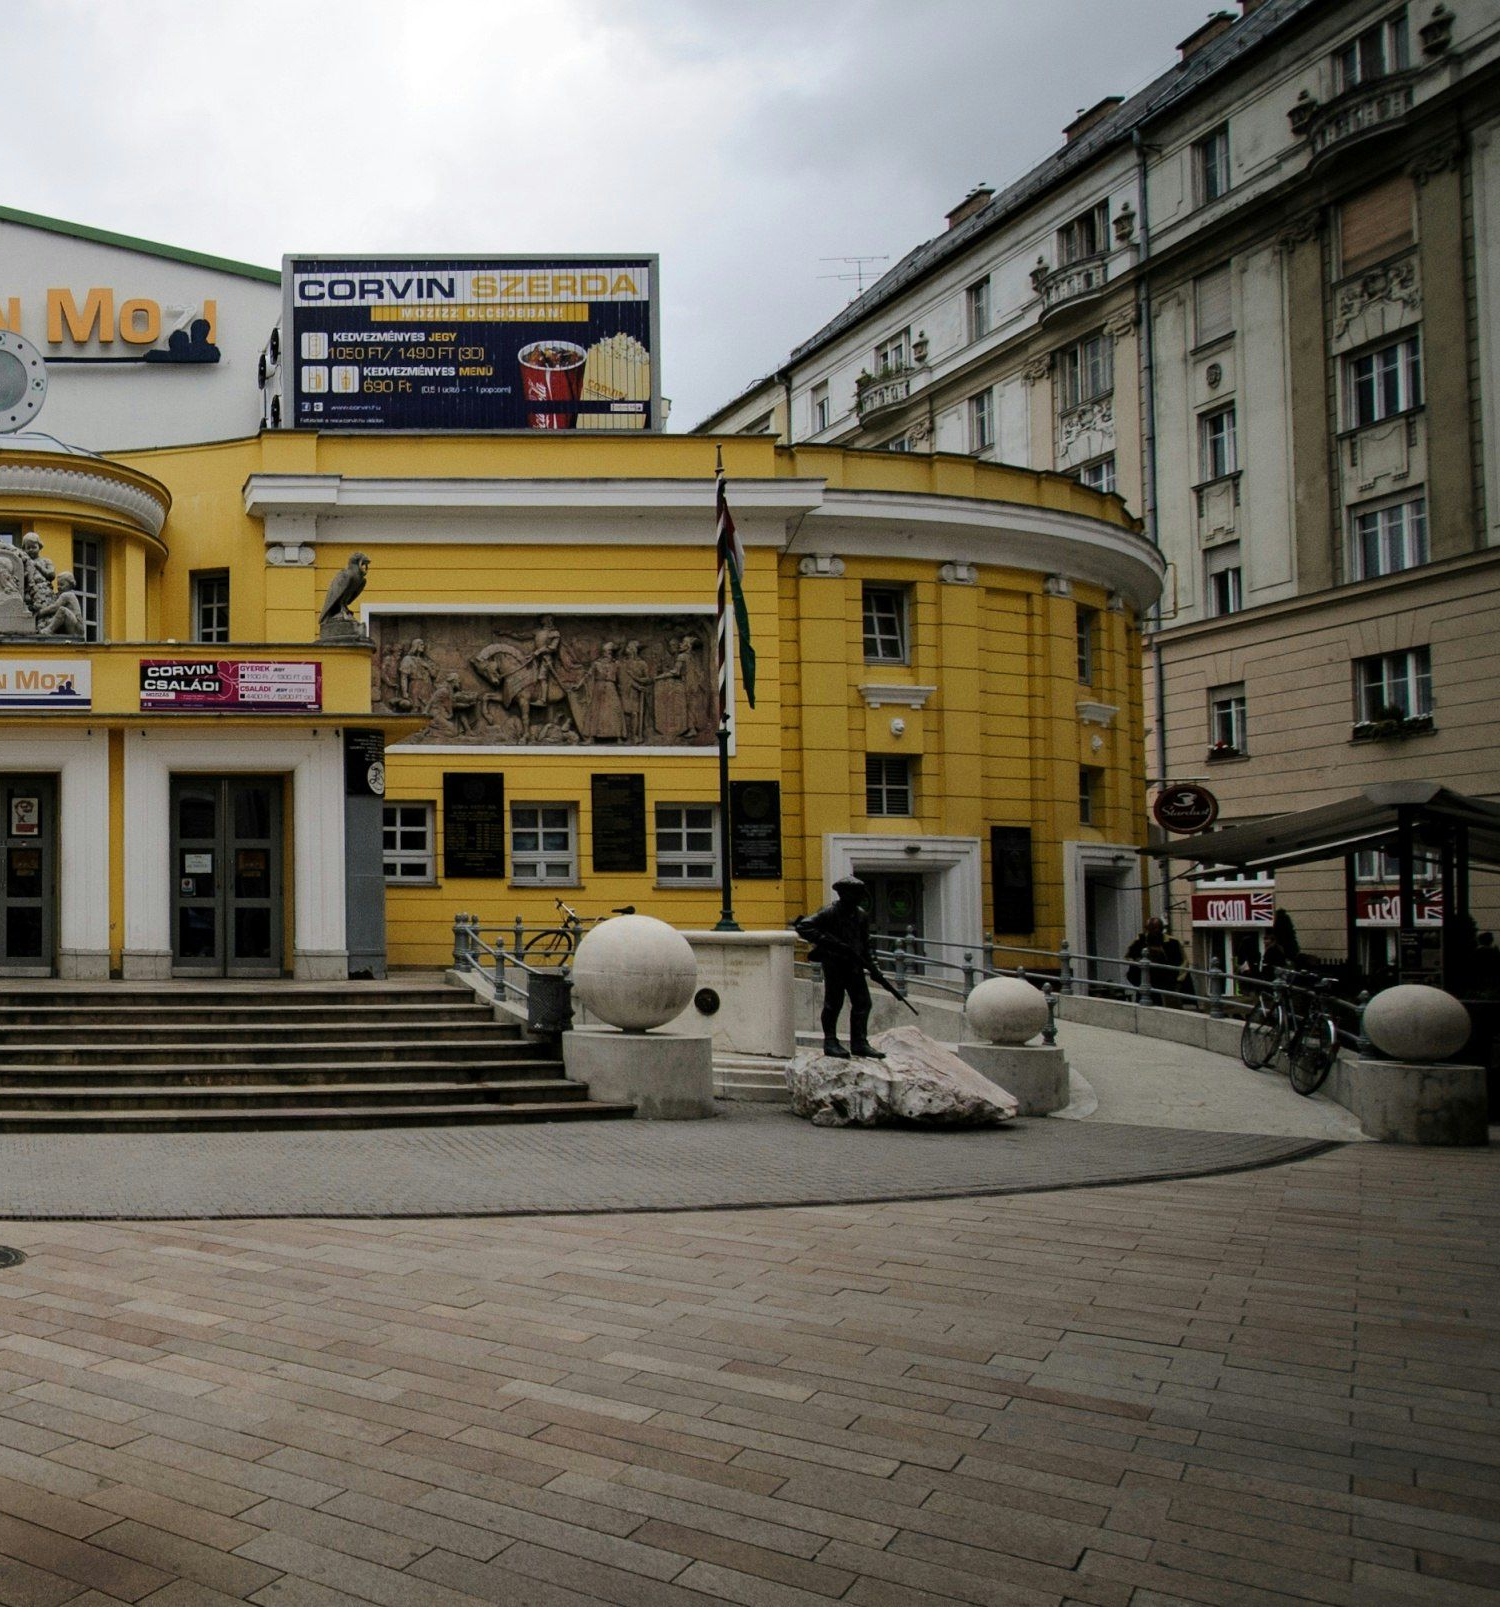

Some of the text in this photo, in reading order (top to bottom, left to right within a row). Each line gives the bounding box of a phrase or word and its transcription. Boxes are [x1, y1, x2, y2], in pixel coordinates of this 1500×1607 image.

[298, 274, 639, 301] CORVIN SZERDA
[401, 303, 564, 318] MOZIZZ OLCSÓBBAN!
[332, 331, 457, 342] KEDVEZMÉNYES JEGY
[328, 346, 365, 360] 1050
[398, 346, 435, 360] 1490
[363, 364, 493, 376] KEDVEZMÉNYES MENÜ
[363, 379, 393, 393] 690
[398, 379, 413, 393] Ft
[147, 664, 214, 677] CORVIN
[15, 670, 75, 690] MOZI
[144, 678, 220, 692] CSALÁDI
[1161, 804, 1210, 817] Stardust
[1206, 899, 1247, 921] cream
[1367, 895, 1417, 920] crea
